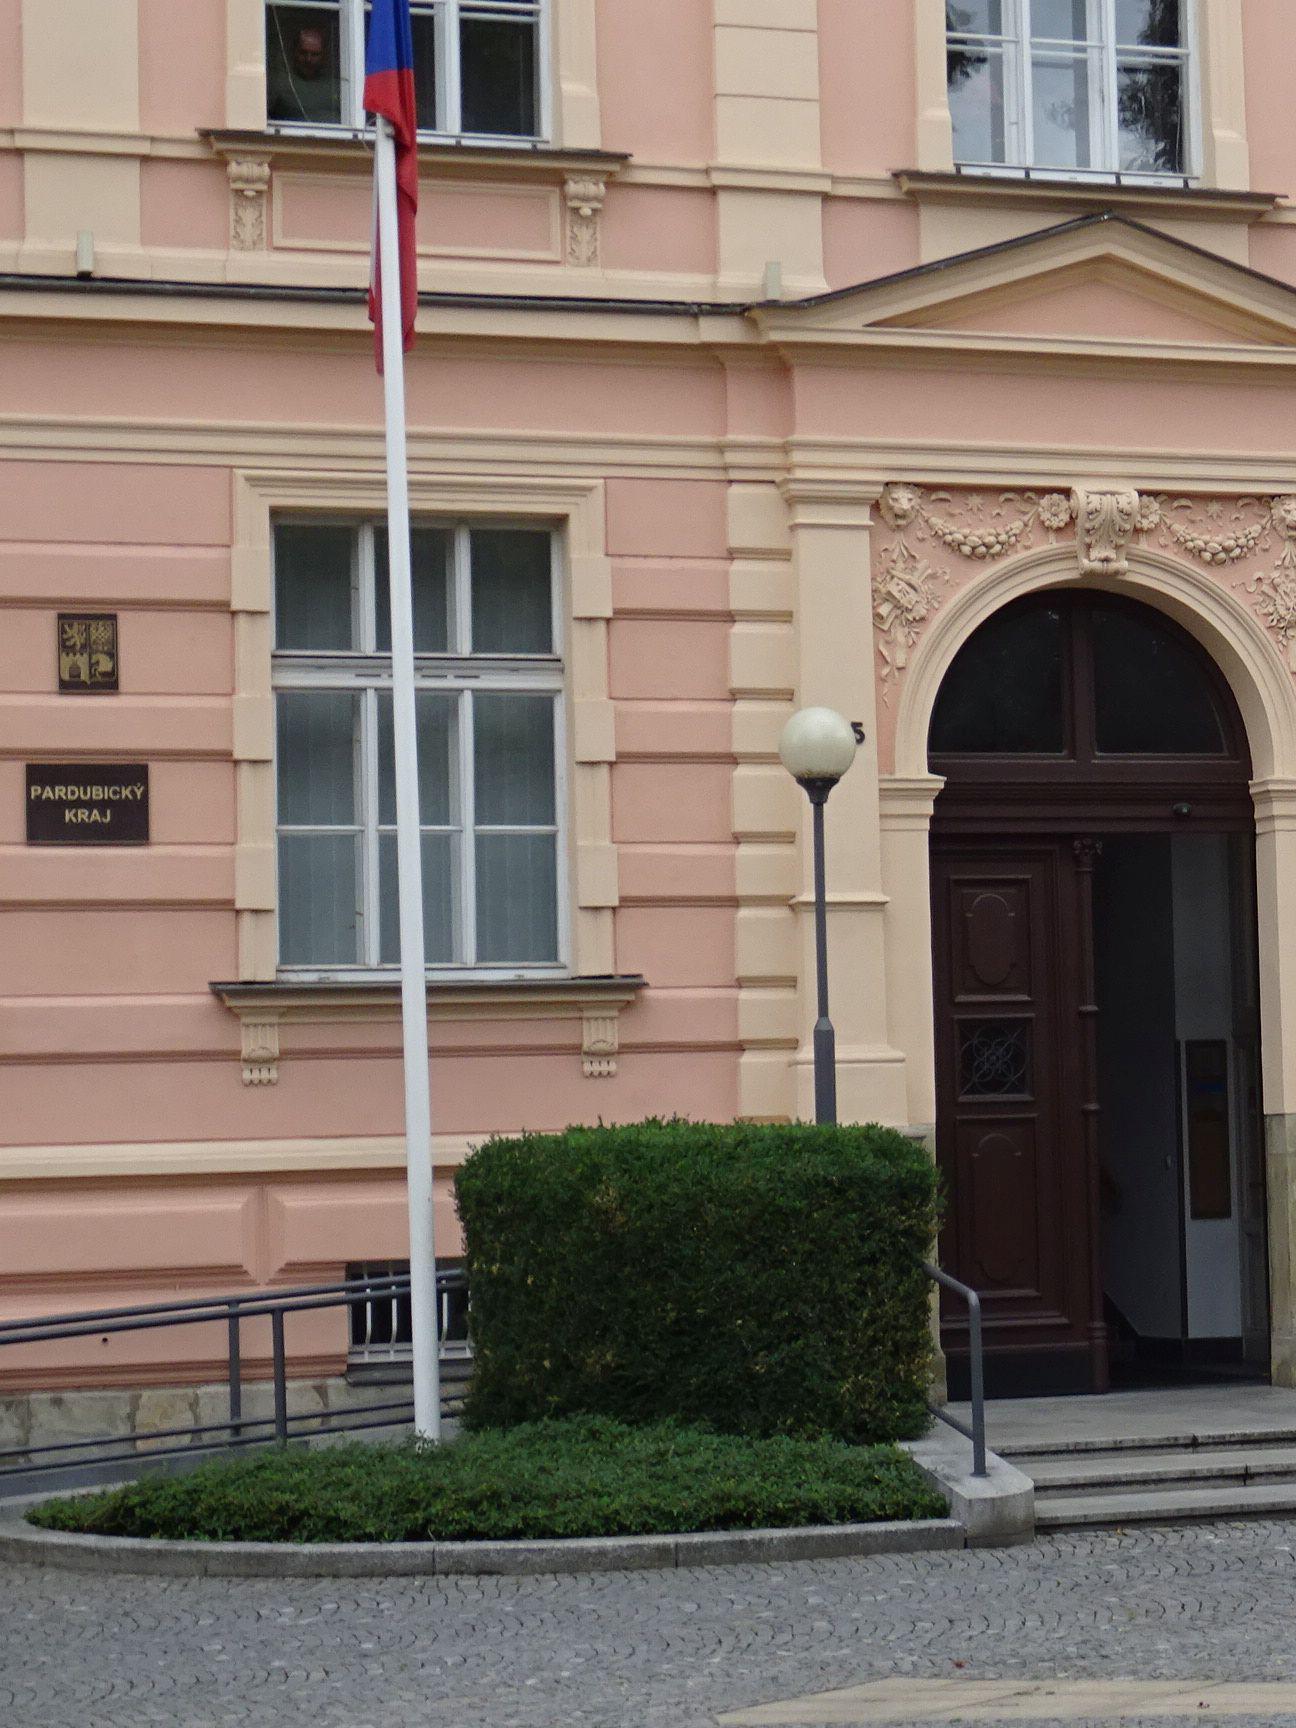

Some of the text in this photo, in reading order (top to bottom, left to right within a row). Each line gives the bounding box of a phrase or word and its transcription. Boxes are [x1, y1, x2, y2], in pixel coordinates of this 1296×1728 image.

[851, 721, 866, 745] 5
[31, 782, 145, 800] PARDUBICKÝ
[65, 808, 111, 823] KRAJ
